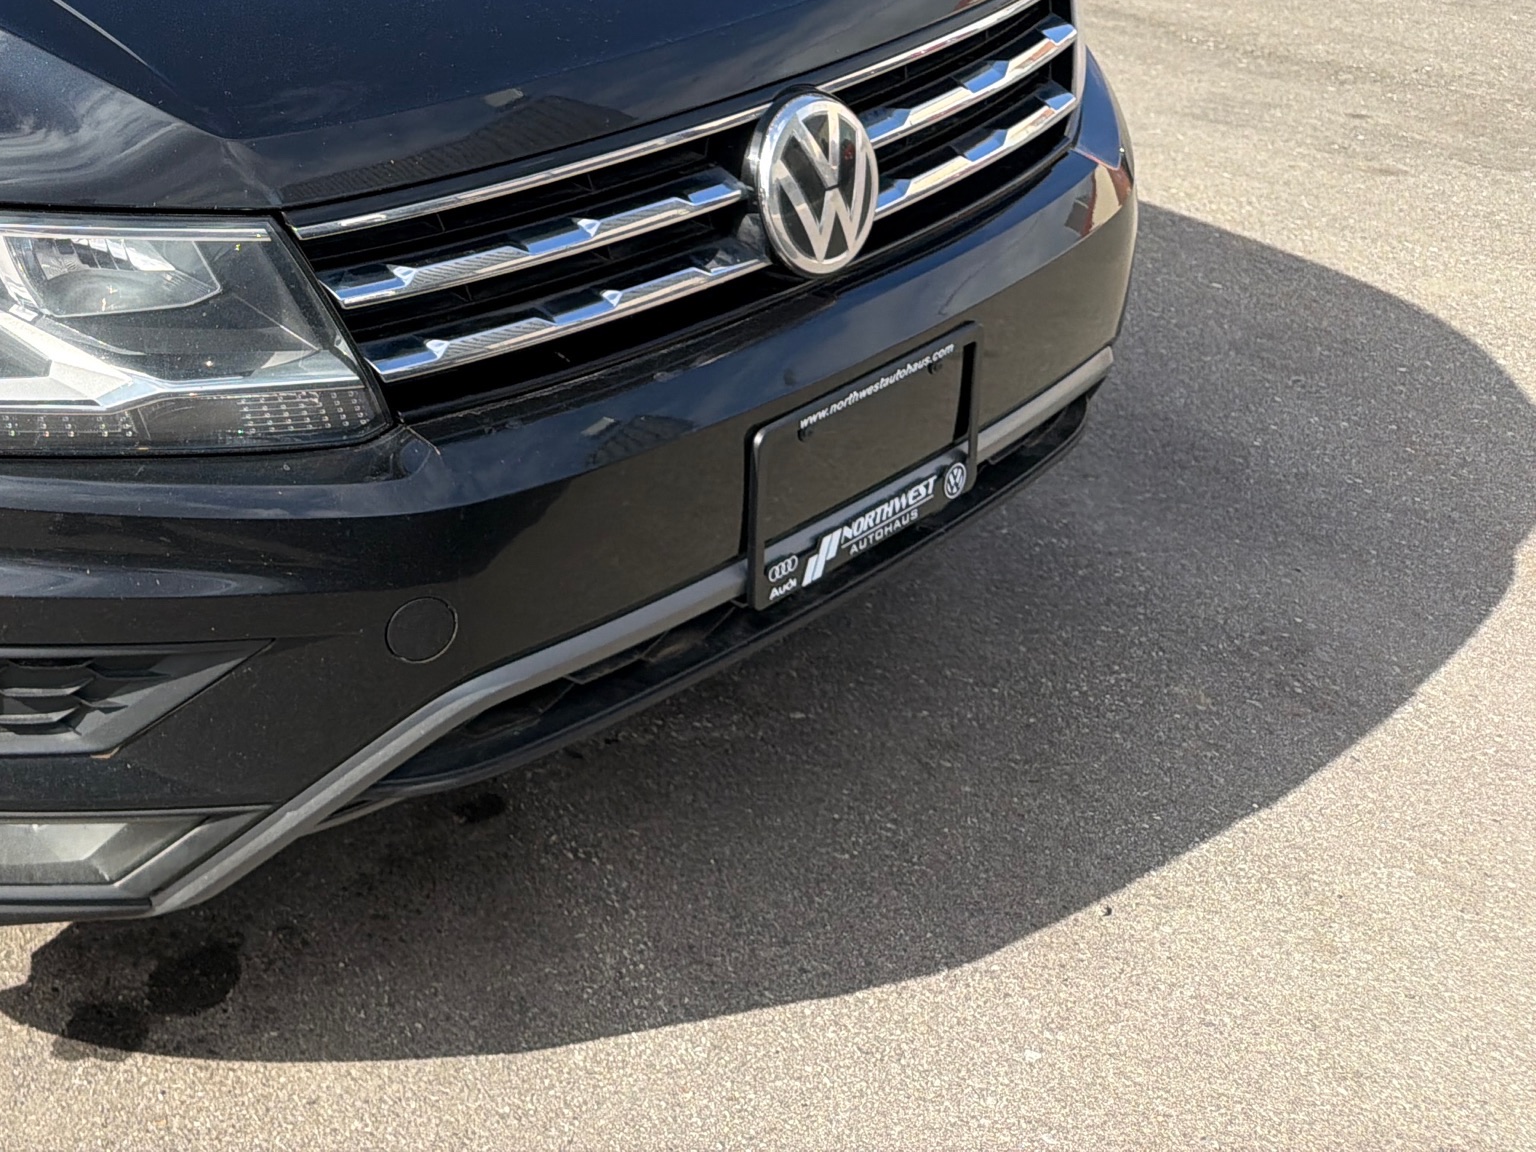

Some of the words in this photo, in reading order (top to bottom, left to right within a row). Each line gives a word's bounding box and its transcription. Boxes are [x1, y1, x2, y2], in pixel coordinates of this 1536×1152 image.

[760, 96, 879, 274] VW
[799, 343, 955, 429] www.northwestautohaus.com
[840, 475, 938, 544] NORTHWEST
[944, 462, 967, 499] VW
[849, 508, 919, 555] AUTOHAUS
[769, 576, 798, 600] Audi
